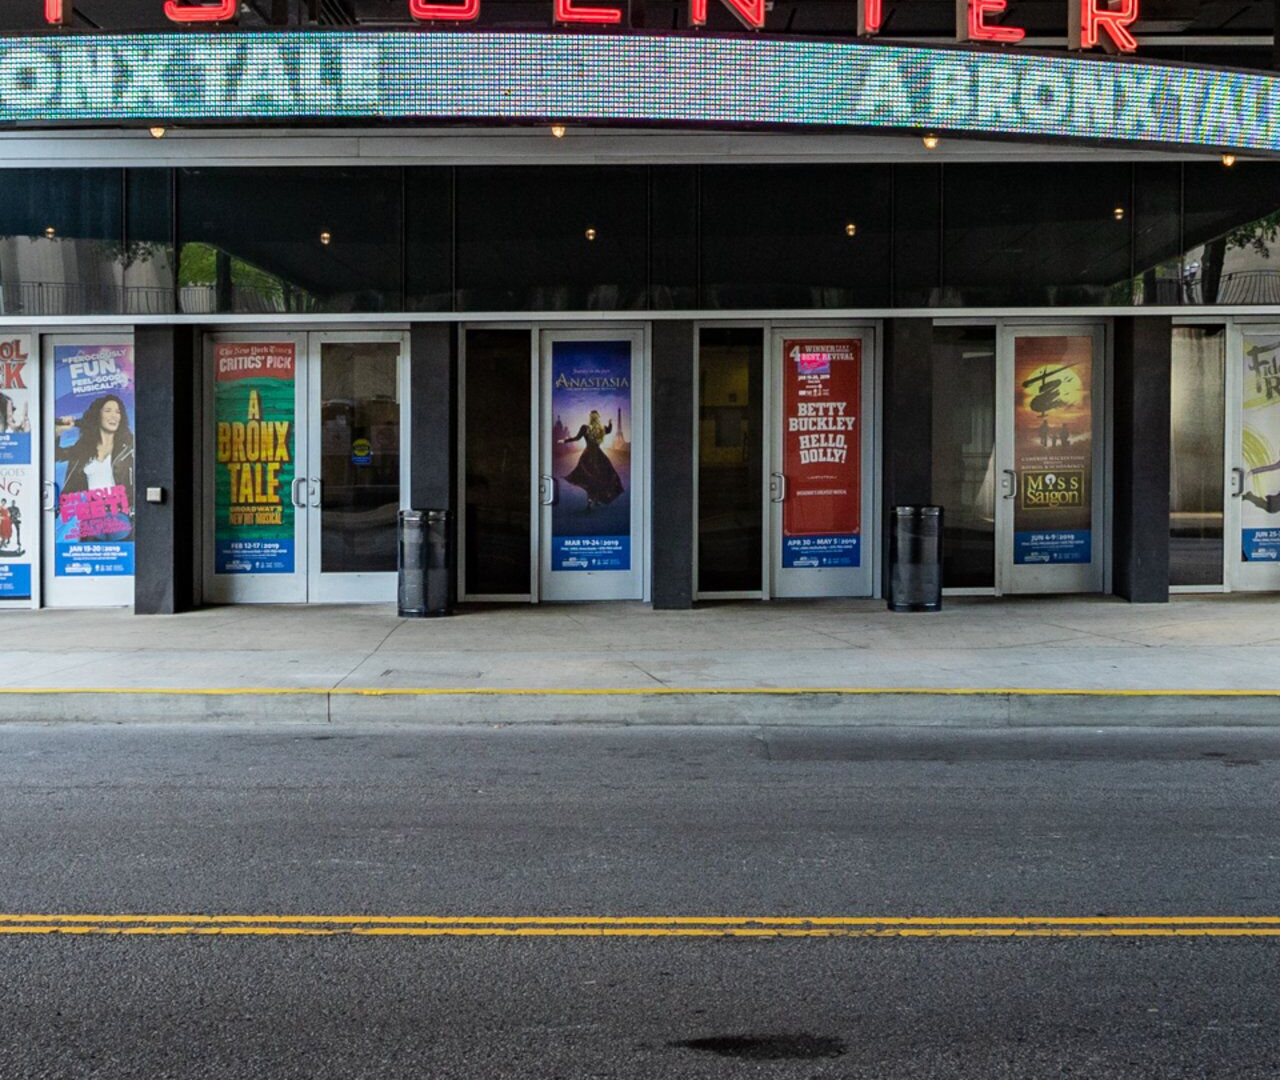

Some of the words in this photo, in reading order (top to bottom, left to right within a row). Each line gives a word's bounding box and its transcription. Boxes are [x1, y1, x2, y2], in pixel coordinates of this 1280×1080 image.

[173, 41, 380, 104] TALE
[855, 58, 910, 115] A
[928, 59, 1161, 134] BRONX
[250, 346, 268, 355] York
[789, 345, 800, 362] 4
[70, 358, 120, 379] FUN,
[266, 356, 292, 369] PICK
[556, 373, 629, 388] ANASTASIA
[247, 390, 260, 420] A
[797, 402, 847, 418] BETTY
[789, 417, 856, 433] BUCKLEY
[217, 421, 289, 462] BRONX
[799, 433, 848, 449] HELLO,
[800, 448, 847, 465] DOLLY!
[0, 468, 25, 476] GOES
[228, 462, 280, 504] TALE
[87, 485, 126, 502] YOUR
[1027, 488, 1078, 507] Saigon
[60, 496, 129, 523] FEET!
